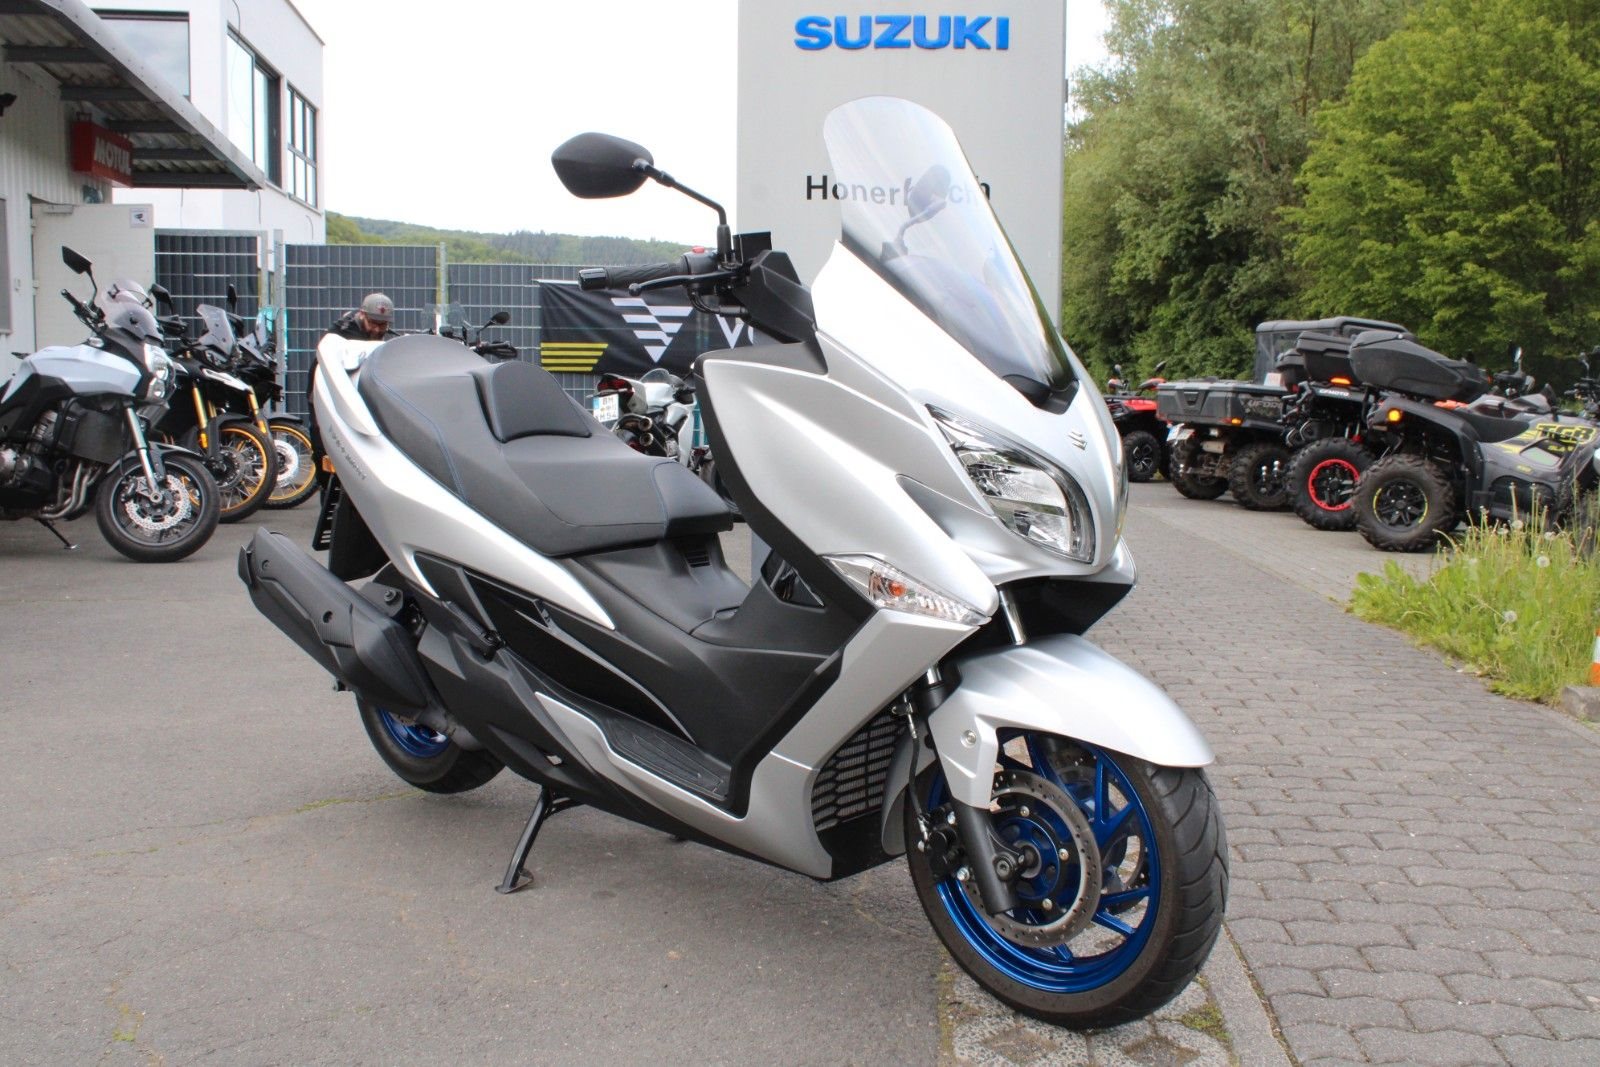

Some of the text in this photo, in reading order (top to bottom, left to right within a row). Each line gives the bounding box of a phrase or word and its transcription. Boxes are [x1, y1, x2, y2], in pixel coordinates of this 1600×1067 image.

[794, 15, 1010, 50] SUZUKI
[94, 137, 132, 175] MOTUL
[806, 173, 991, 206] Honerch
[1319, 388, 1350, 398] CFMOTO
[1537, 423, 1597, 445] TGB
